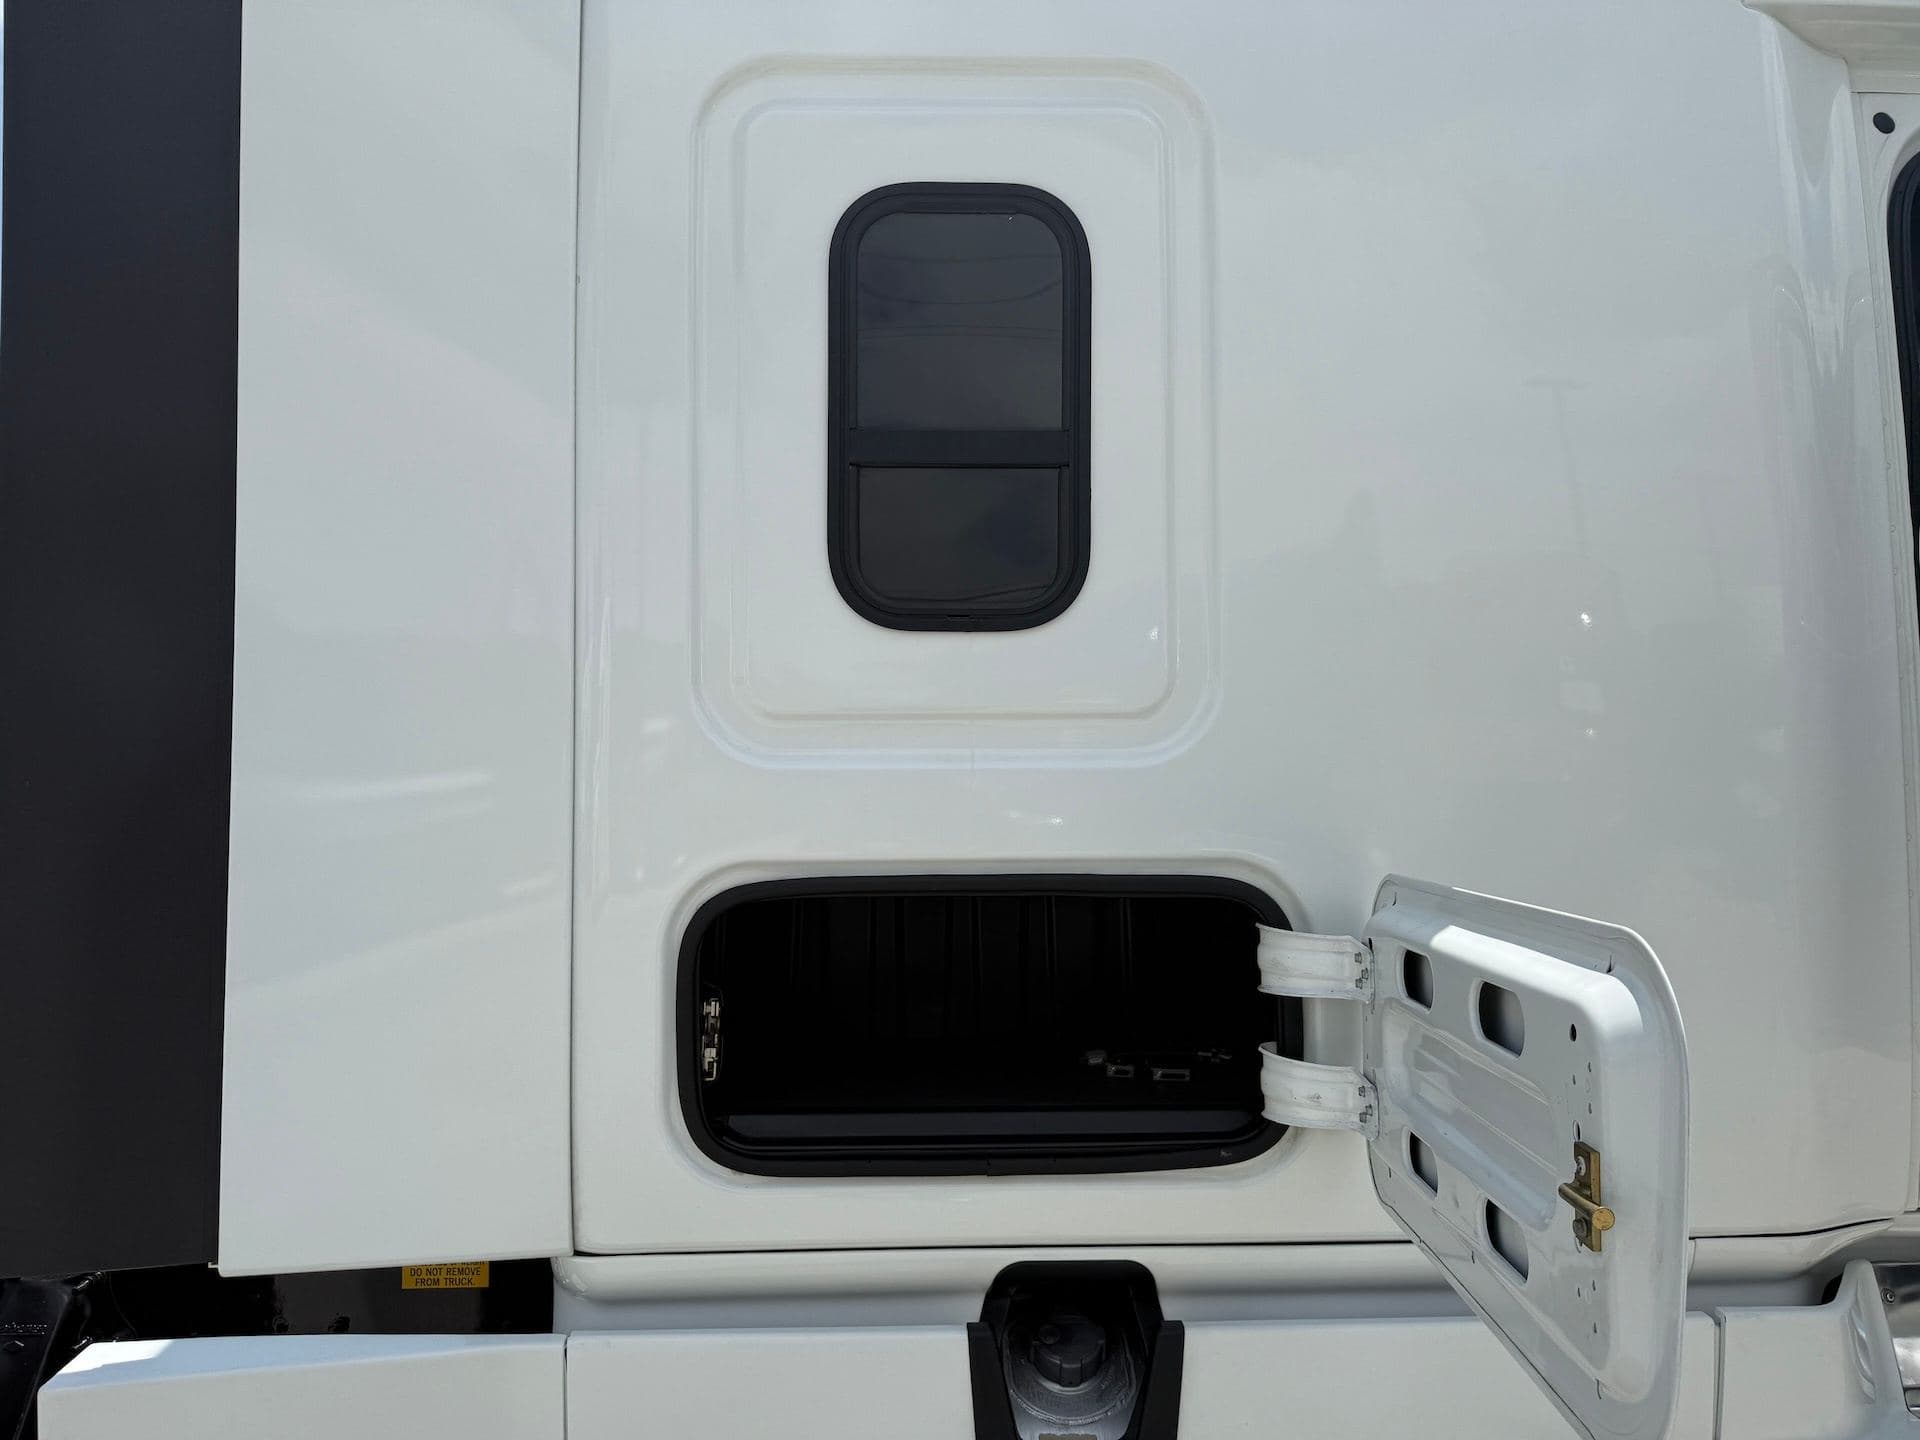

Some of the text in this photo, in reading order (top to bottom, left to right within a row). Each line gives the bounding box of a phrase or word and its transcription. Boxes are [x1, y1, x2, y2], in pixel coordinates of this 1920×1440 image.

[410, 1267, 481, 1276] DO NOT REMOVE
[415, 1277, 440, 1287] FROM
